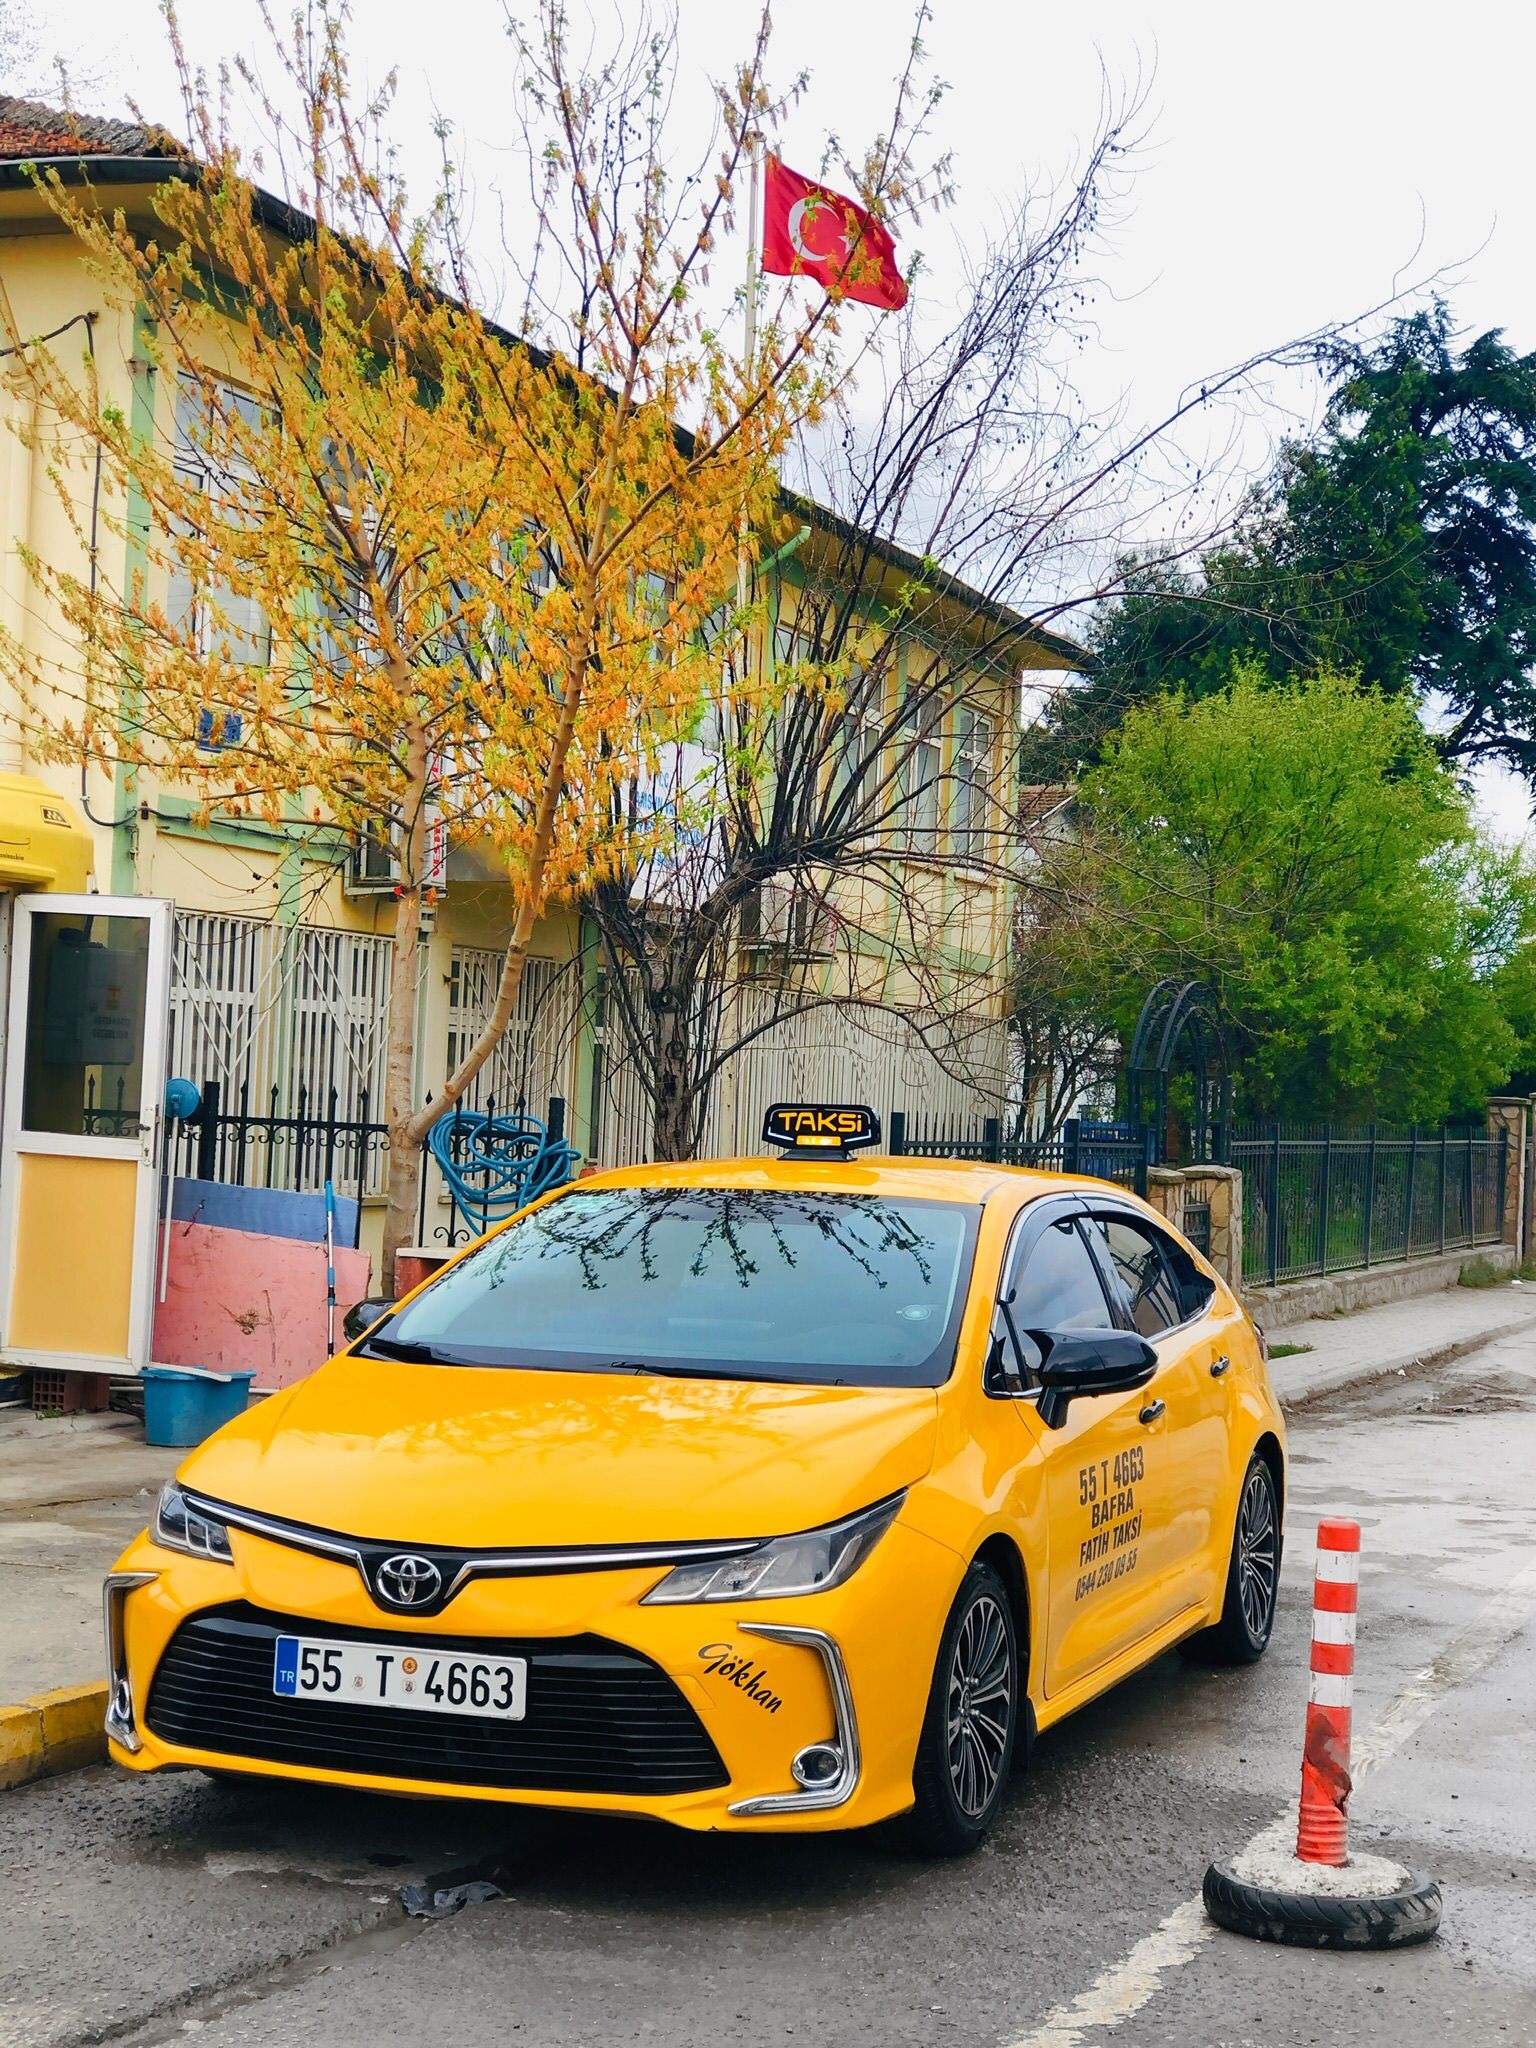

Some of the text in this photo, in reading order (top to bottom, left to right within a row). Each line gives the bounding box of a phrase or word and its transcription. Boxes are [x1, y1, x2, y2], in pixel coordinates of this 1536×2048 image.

[1079, 1445, 1144, 1506] 55 T 4663
[1091, 1488, 1134, 1529] BAFRA
[1080, 1509, 1142, 1568] FATİH TAKSİ
[1075, 1570, 1097, 1602] 0544
[1097, 1560, 1114, 1588] 230
[1126, 1547, 1138, 1572] 55
[280, 1670, 295, 1684] TR
[300, 1647, 514, 1710] 55 T 4663
[698, 1643, 783, 1714] Gökhan
